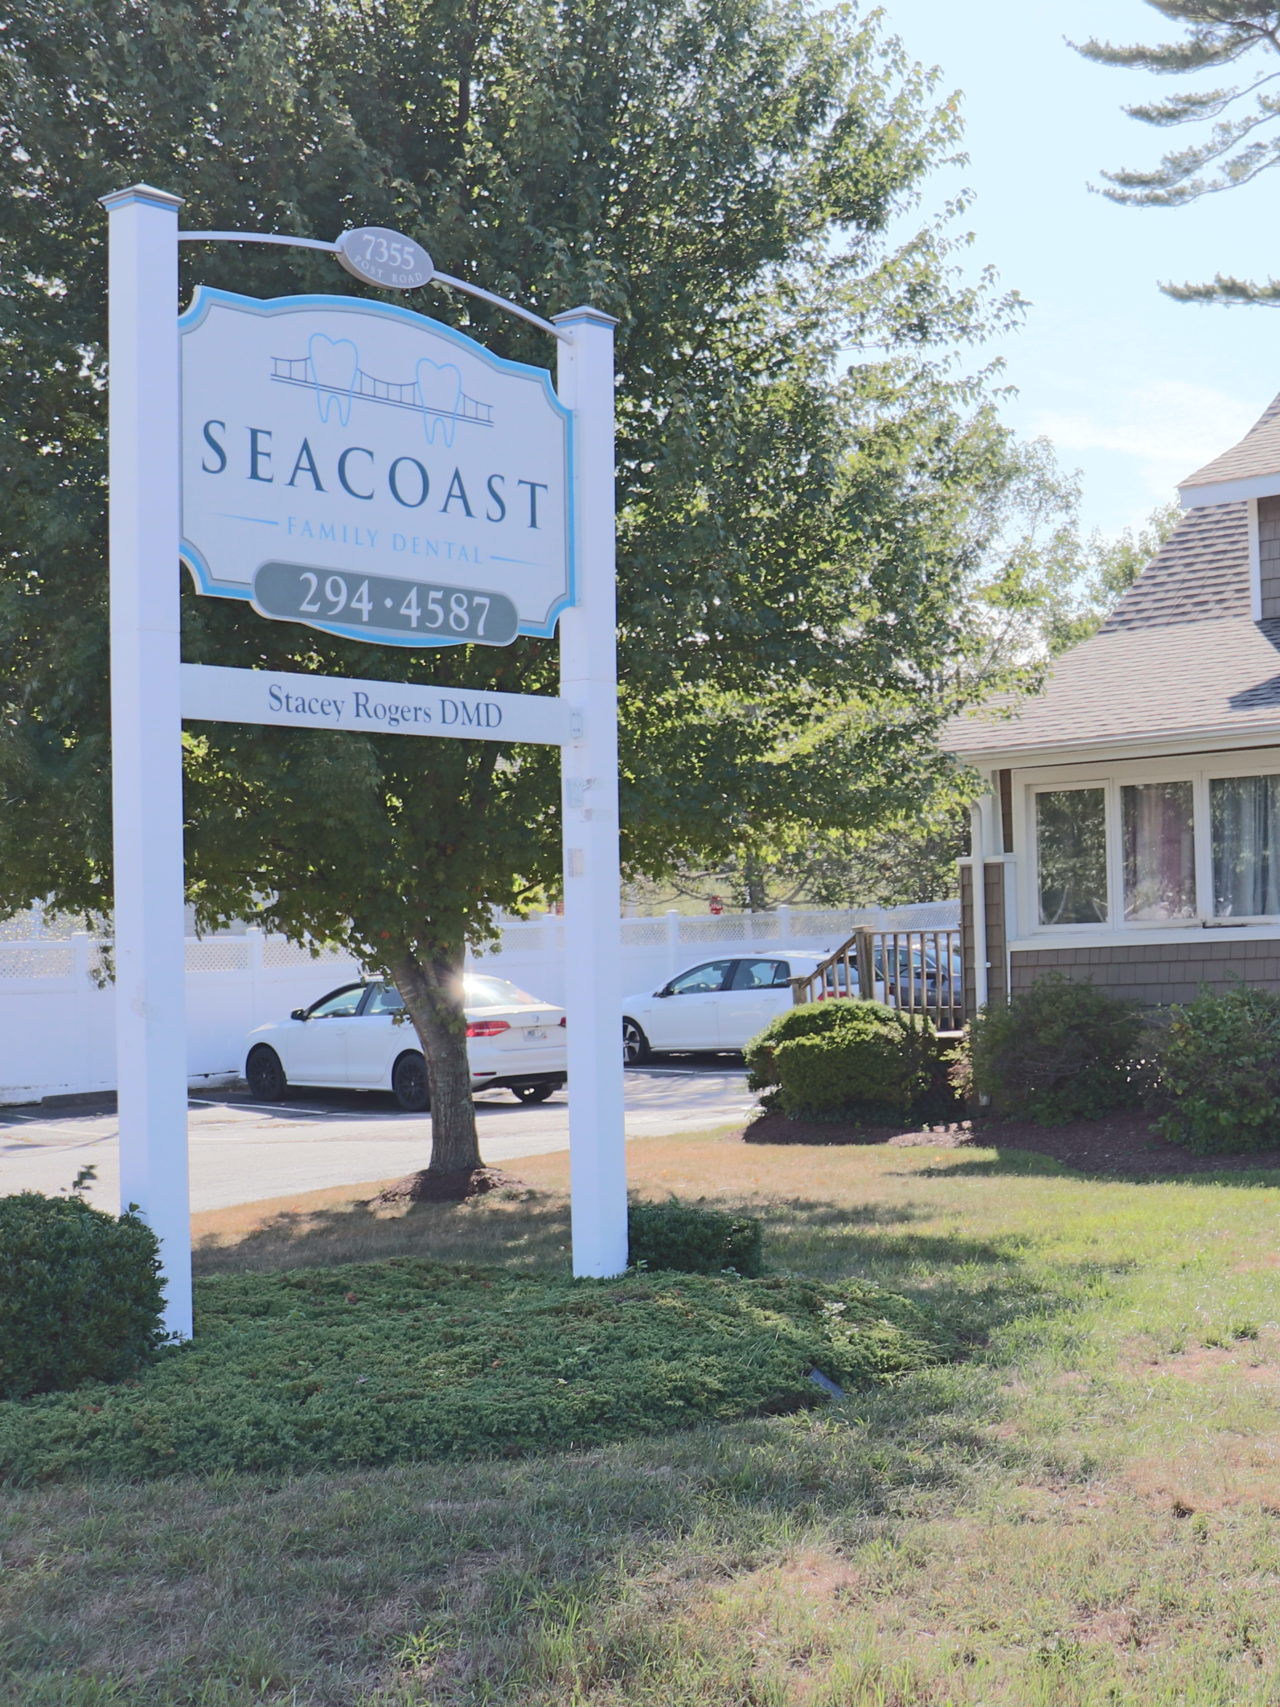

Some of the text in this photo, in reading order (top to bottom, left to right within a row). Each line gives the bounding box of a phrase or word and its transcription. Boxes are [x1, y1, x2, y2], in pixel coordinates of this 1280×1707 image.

[354, 255, 423, 284] POST ROAD
[363, 234, 415, 270] 7355
[201, 419, 549, 530] SEACOAST
[287, 516, 482, 564] FAMILY DENTAL
[268, 684, 503, 729] Stacey Rogers DMD
